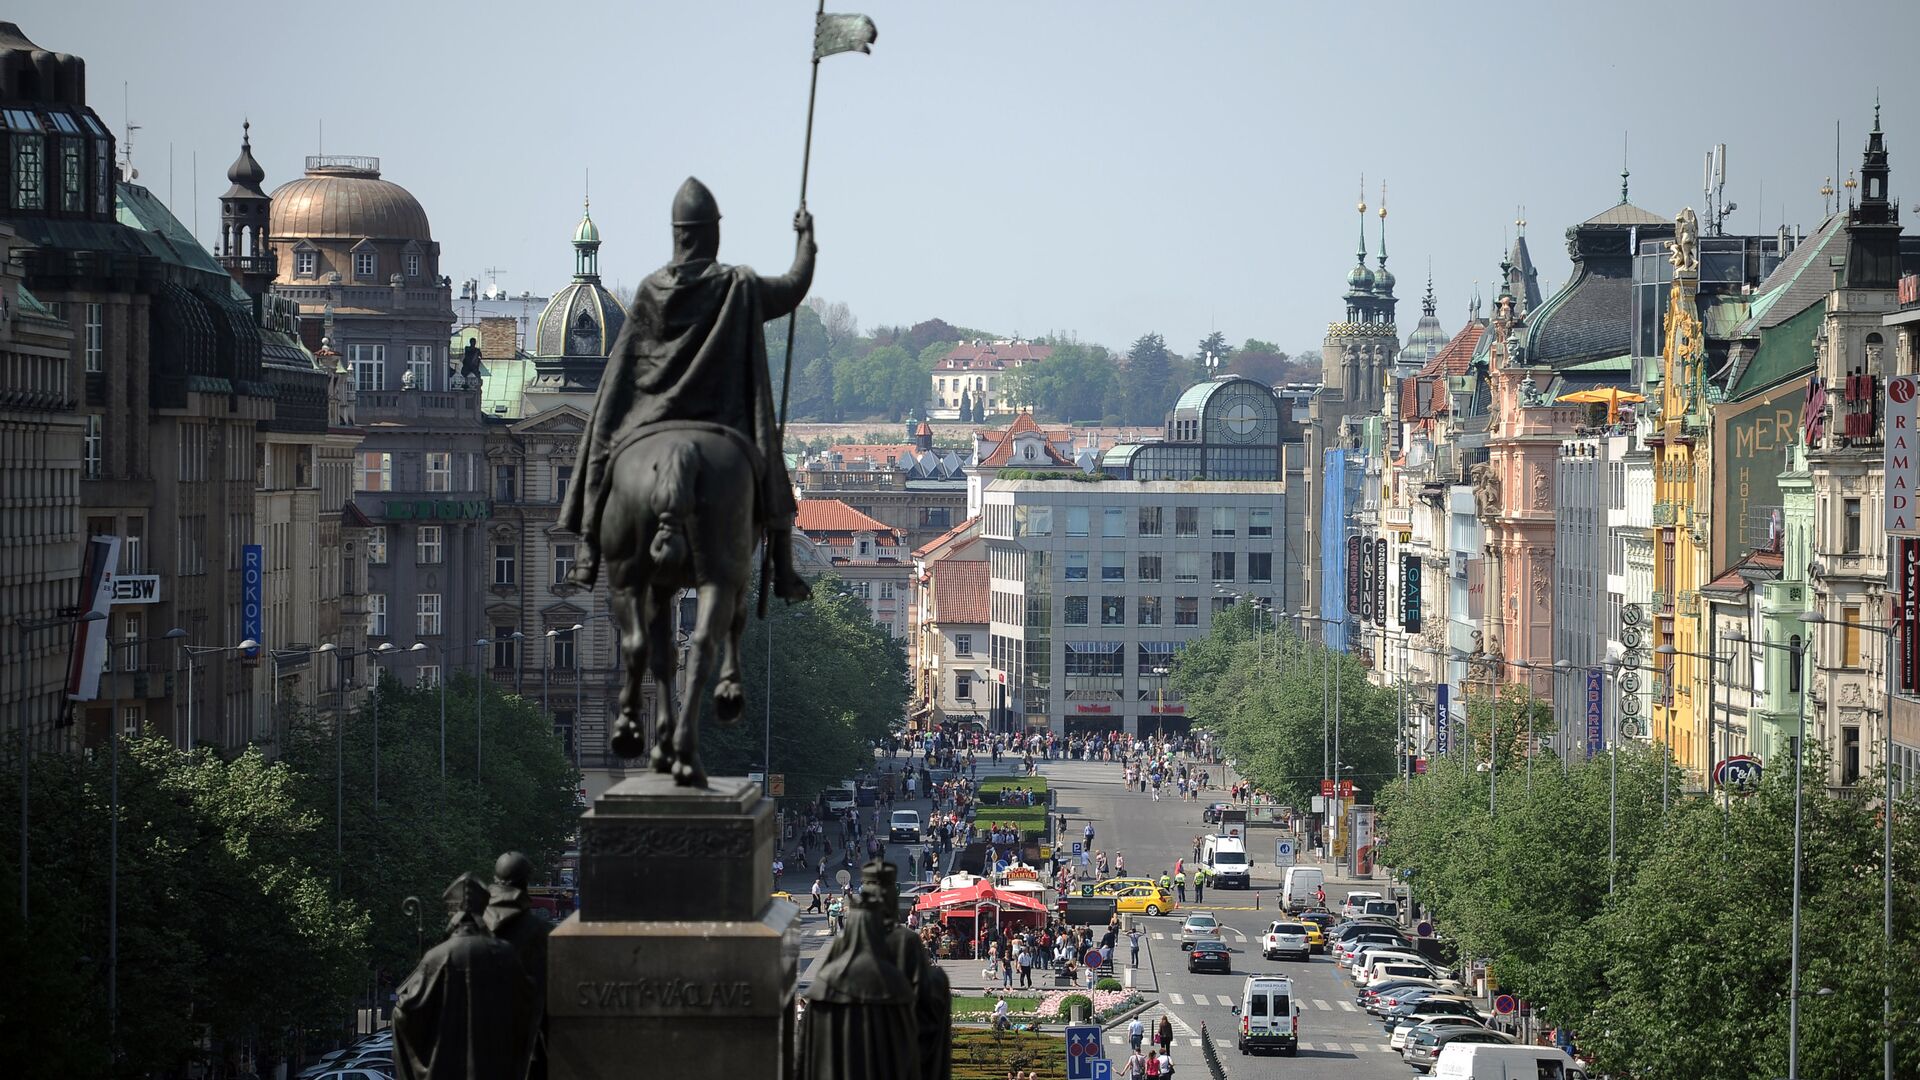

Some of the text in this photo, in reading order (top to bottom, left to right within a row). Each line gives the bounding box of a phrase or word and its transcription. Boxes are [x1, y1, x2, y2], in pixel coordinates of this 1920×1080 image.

[1739, 466, 1750, 544] HOTEL
[1892, 415, 1909, 529] RAMADA
[1363, 542, 1372, 615] CASINO
[1408, 567, 1419, 620] GATE
[1624, 611, 1638, 713] HOTEL
[1728, 765, 1758, 786] C&A
[1095, 1062, 1108, 1079] P
